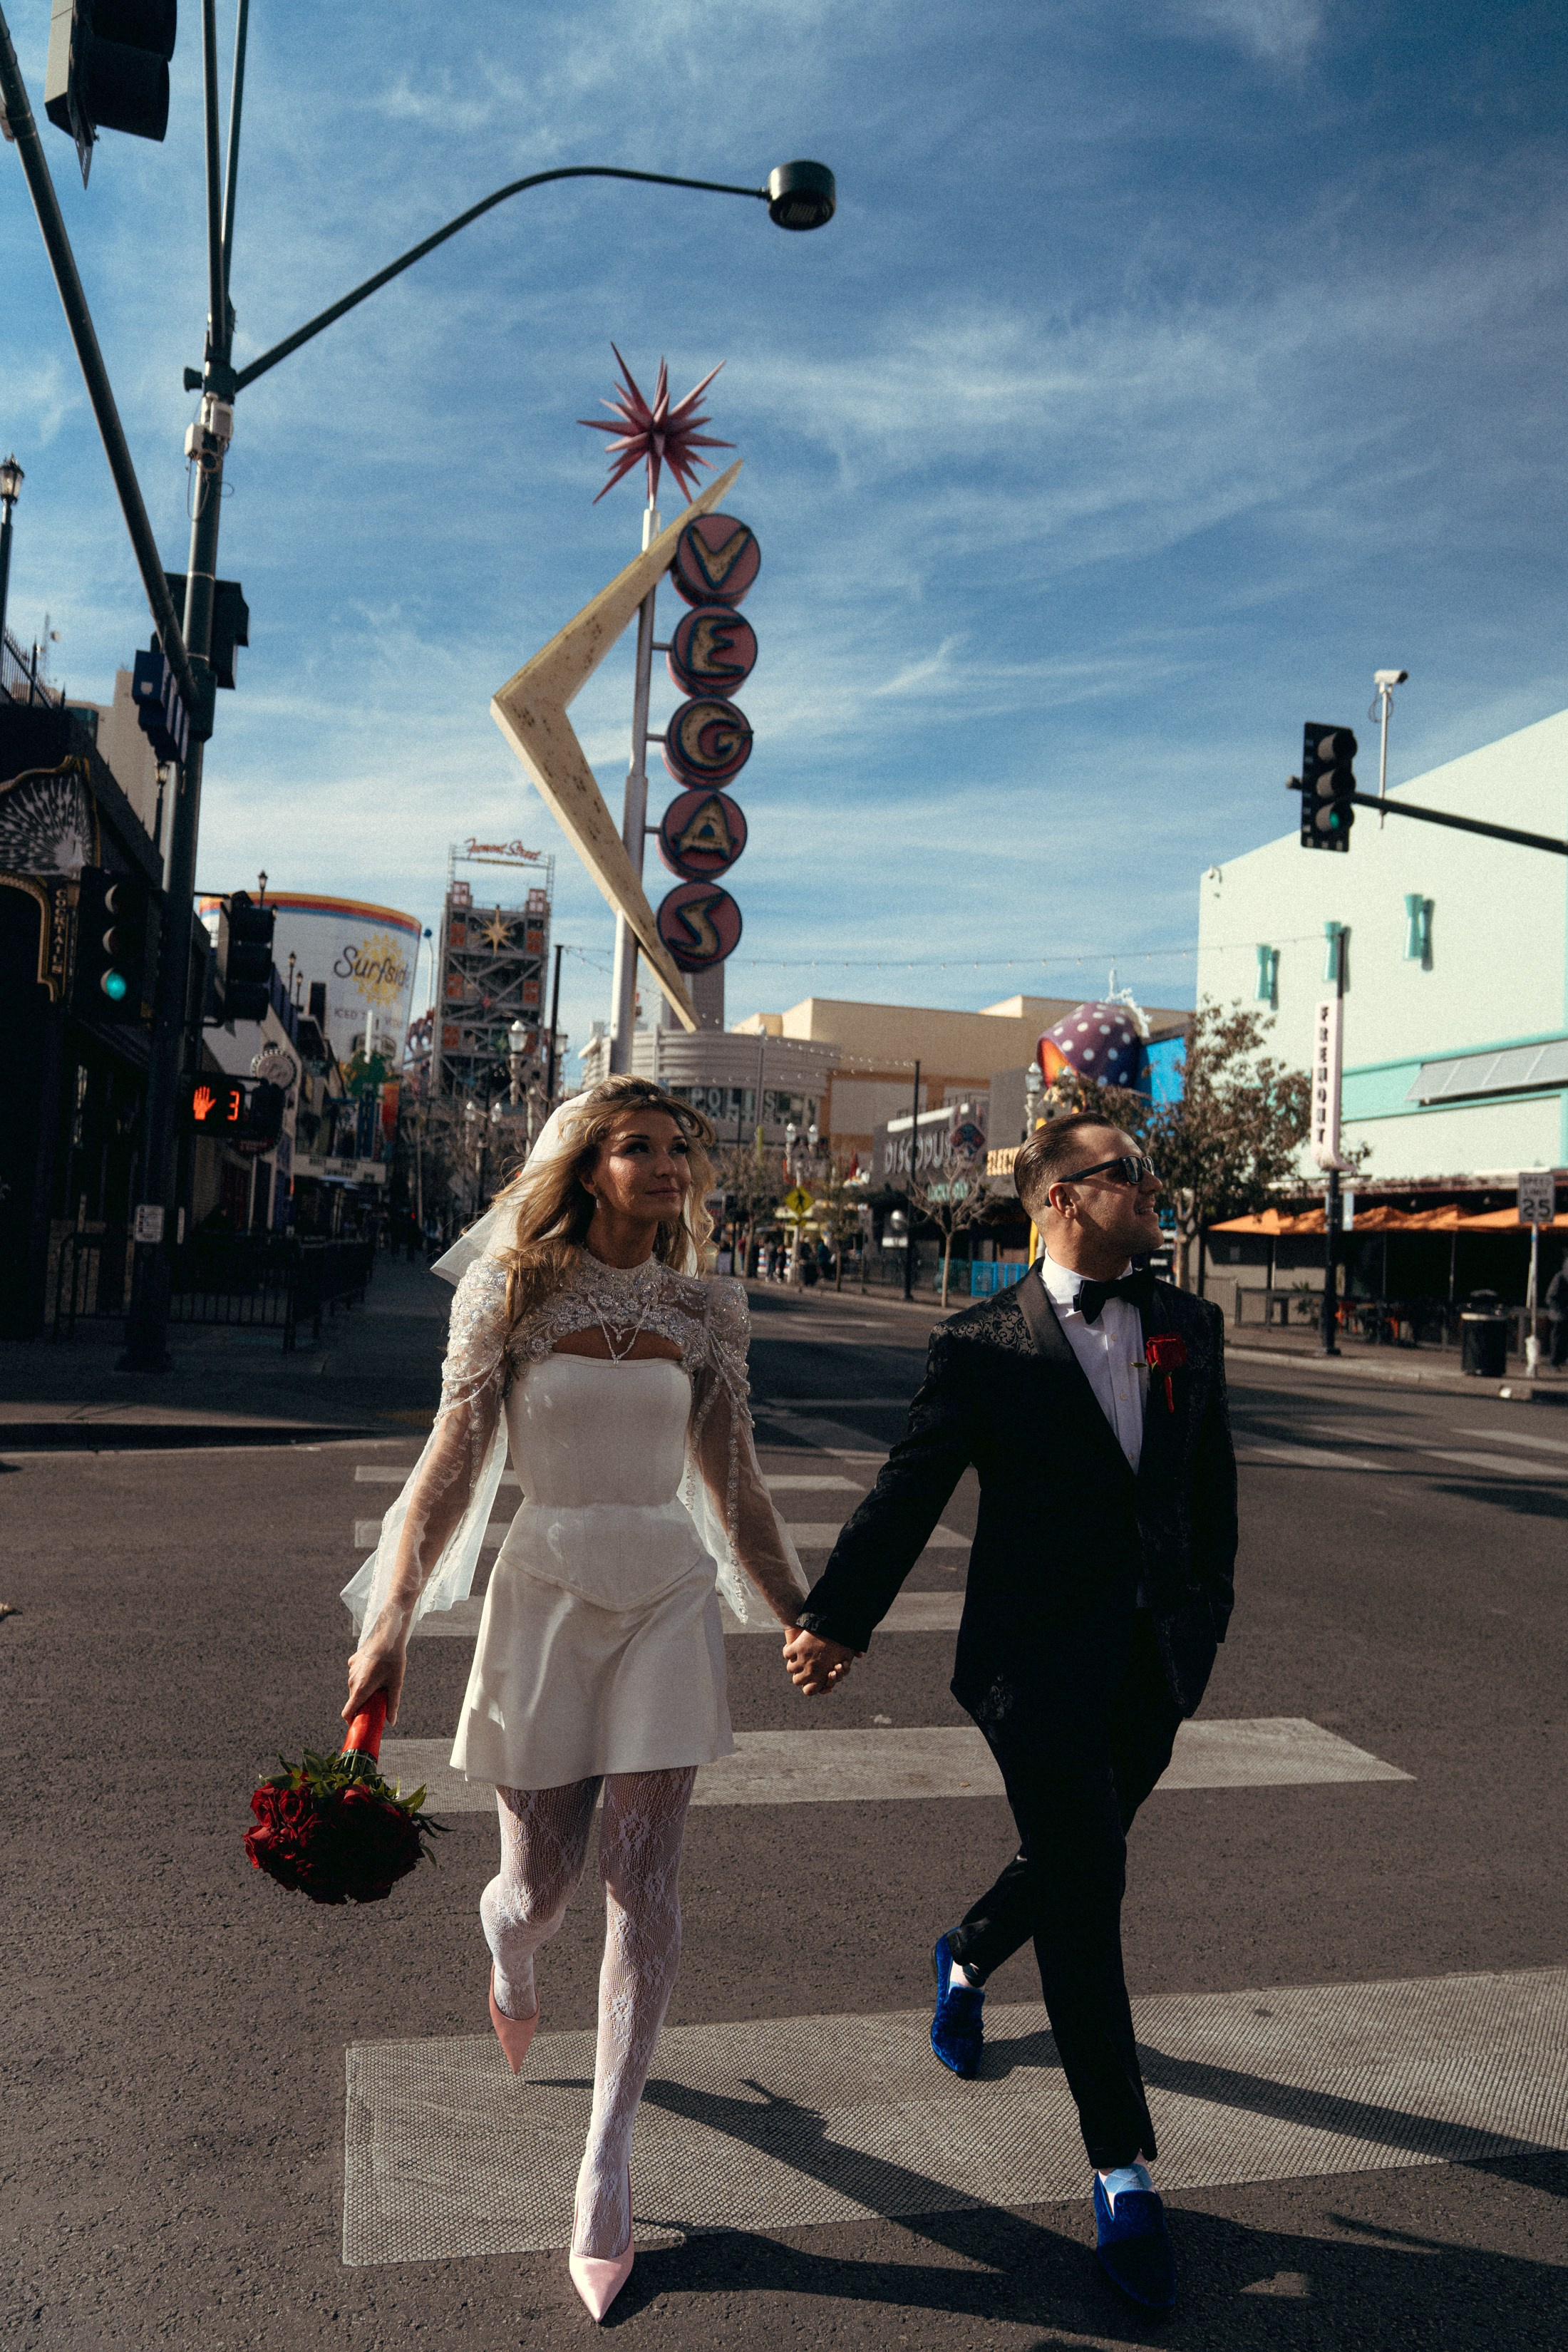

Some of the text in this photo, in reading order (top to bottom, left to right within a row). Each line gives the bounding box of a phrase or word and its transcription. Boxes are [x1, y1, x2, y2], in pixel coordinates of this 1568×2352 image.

[669, 524, 753, 959] VEGAS
[1316, 1006, 1329, 1145] FREMONT
[226, 1089, 241, 1121] 3
[1522, 1177, 1552, 1186] SPEED
[1525, 1188, 1548, 1197] LIMIT
[1522, 1198, 1550, 1217] 25
